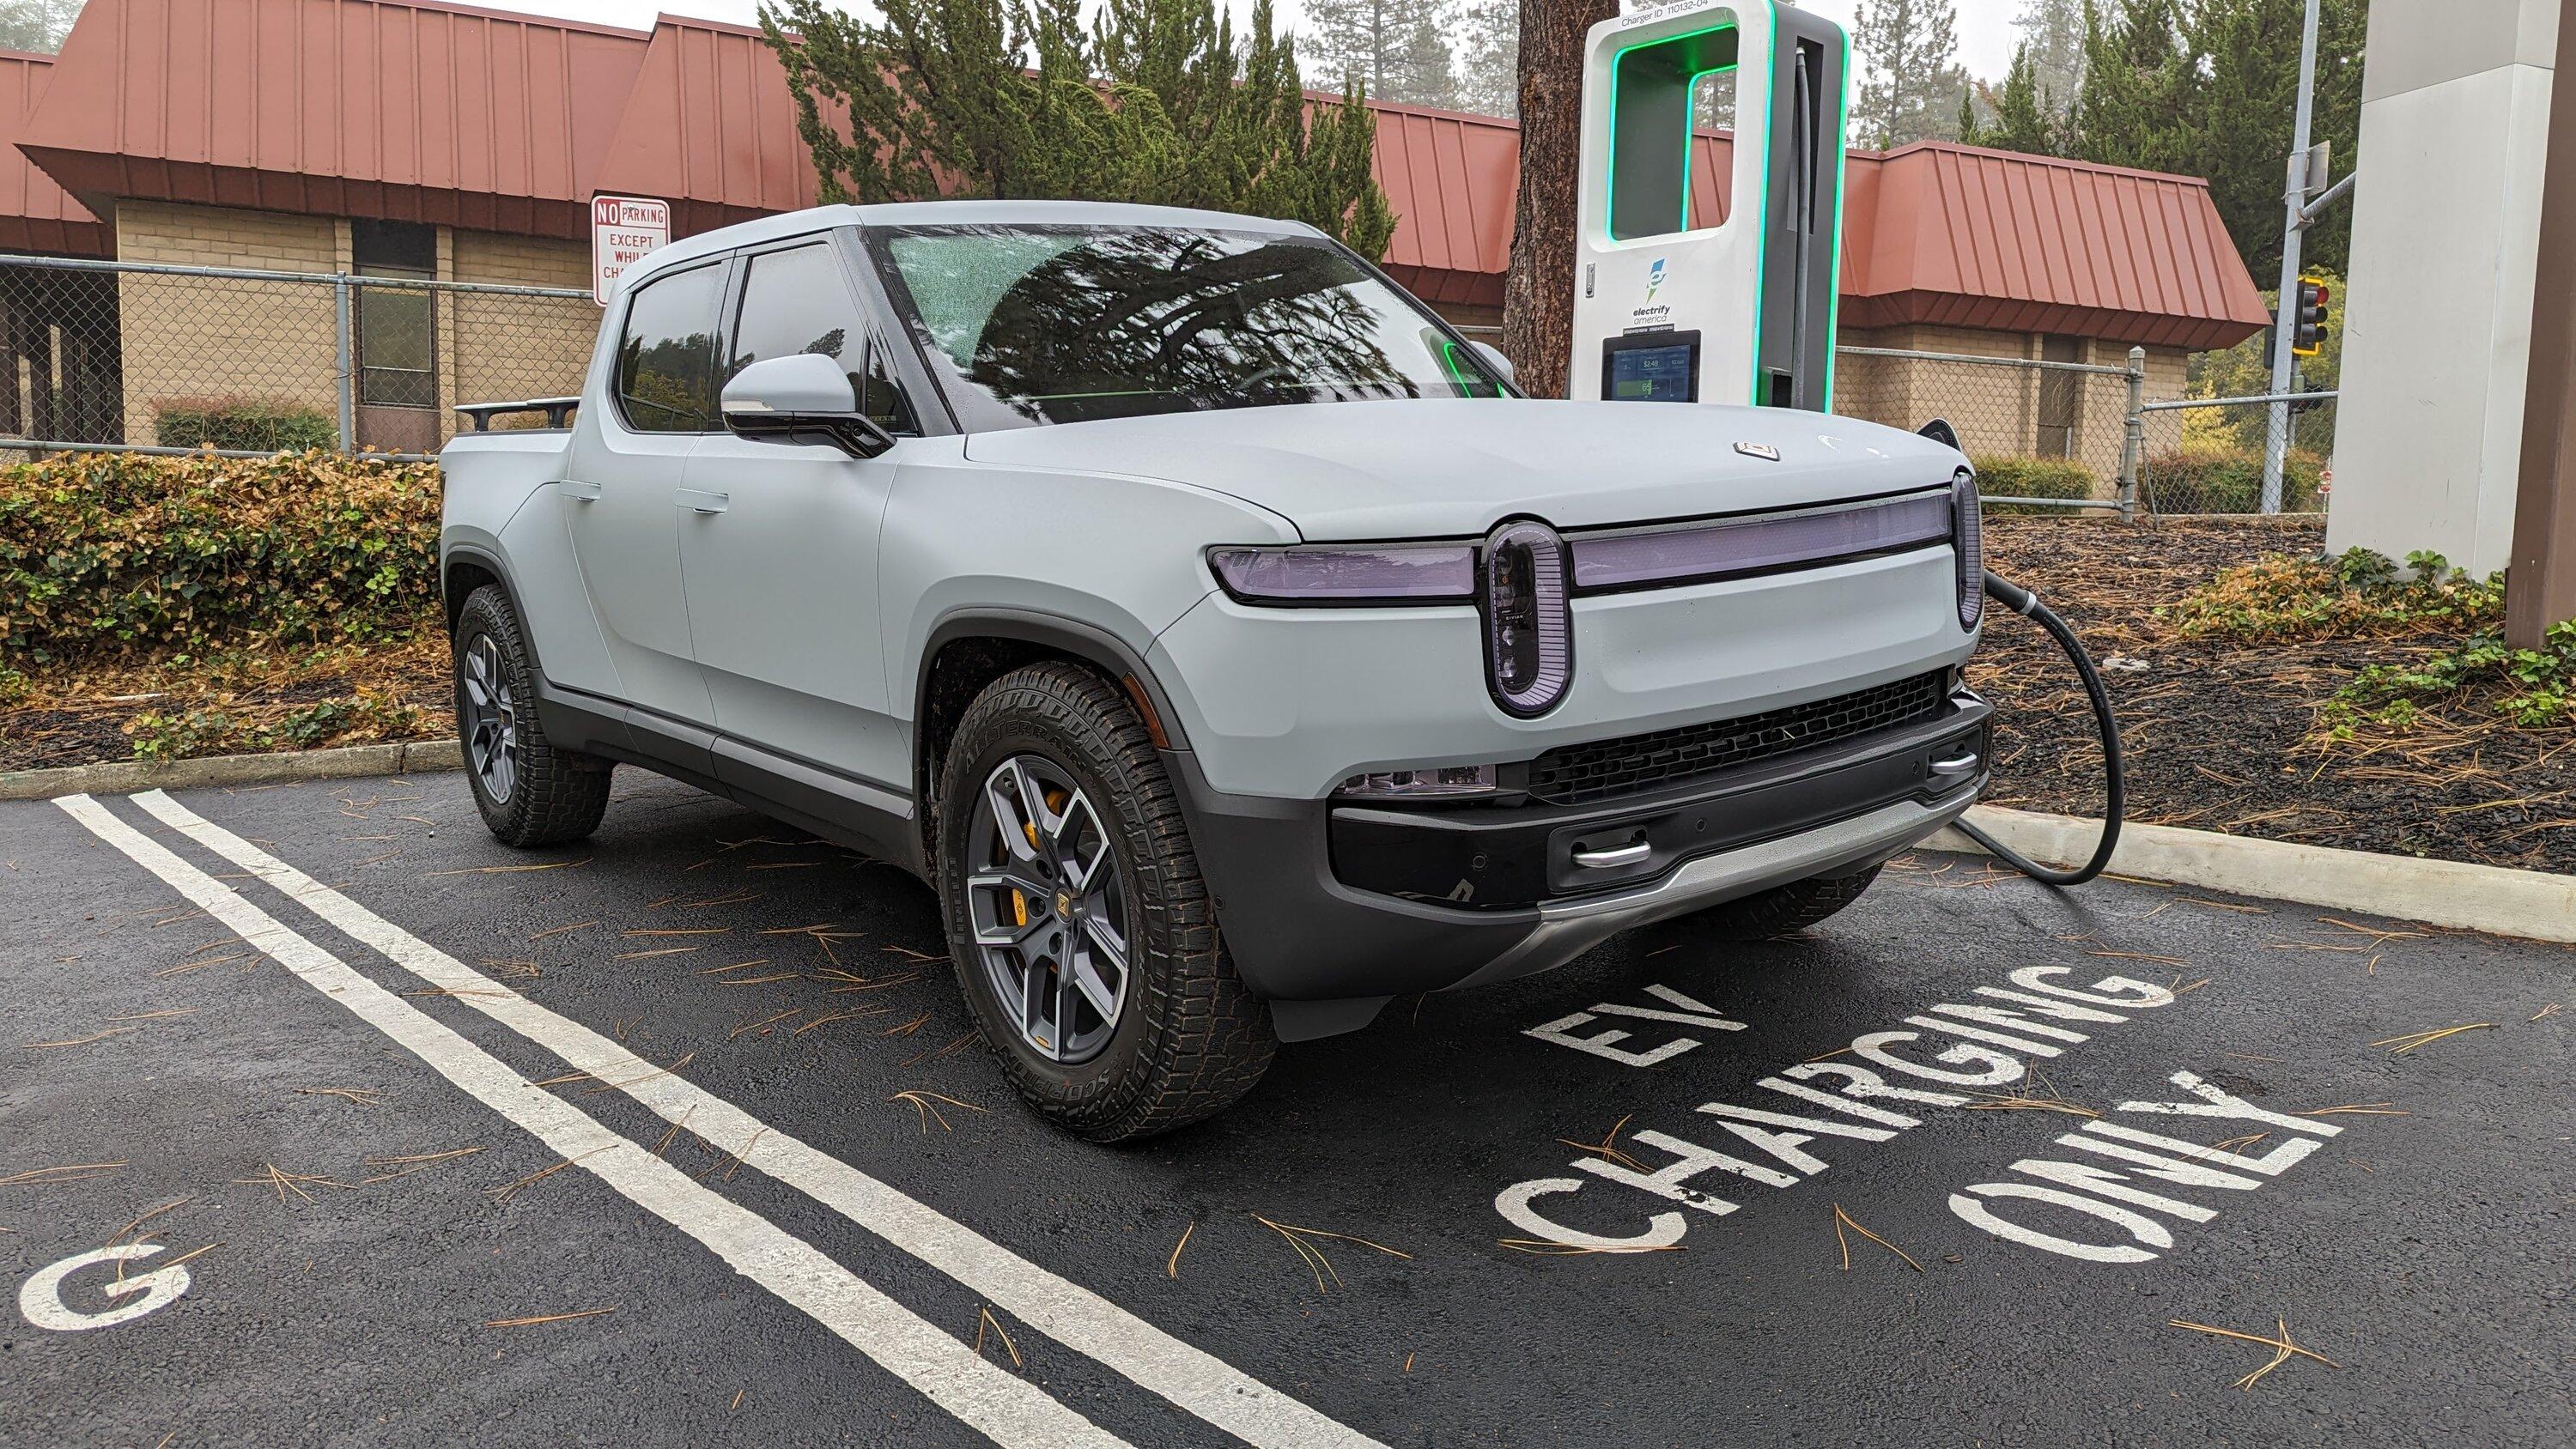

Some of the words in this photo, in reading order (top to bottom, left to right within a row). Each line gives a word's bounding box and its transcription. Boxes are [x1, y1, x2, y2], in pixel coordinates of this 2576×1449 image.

[1621, 13, 1653, 27] Charger
[1654, 9, 1663, 19] ID
[598, 203, 618, 224] NO
[622, 207, 664, 223] PARKING
[610, 233, 653, 248] EXCEPT
[1633, 305, 1670, 316] electrify
[1633, 315, 1667, 324] america
[966, 731, 994, 774] ALL
[993, 718, 1087, 774] TERRAIN
[1522, 984, 1748, 1068] EV
[998, 1044, 1110, 1102] SCORPION
[1494, 966, 2175, 1254] CHARGING
[1947, 1070, 2344, 1264] ONLY
[19, 1243, 191, 1331] G
